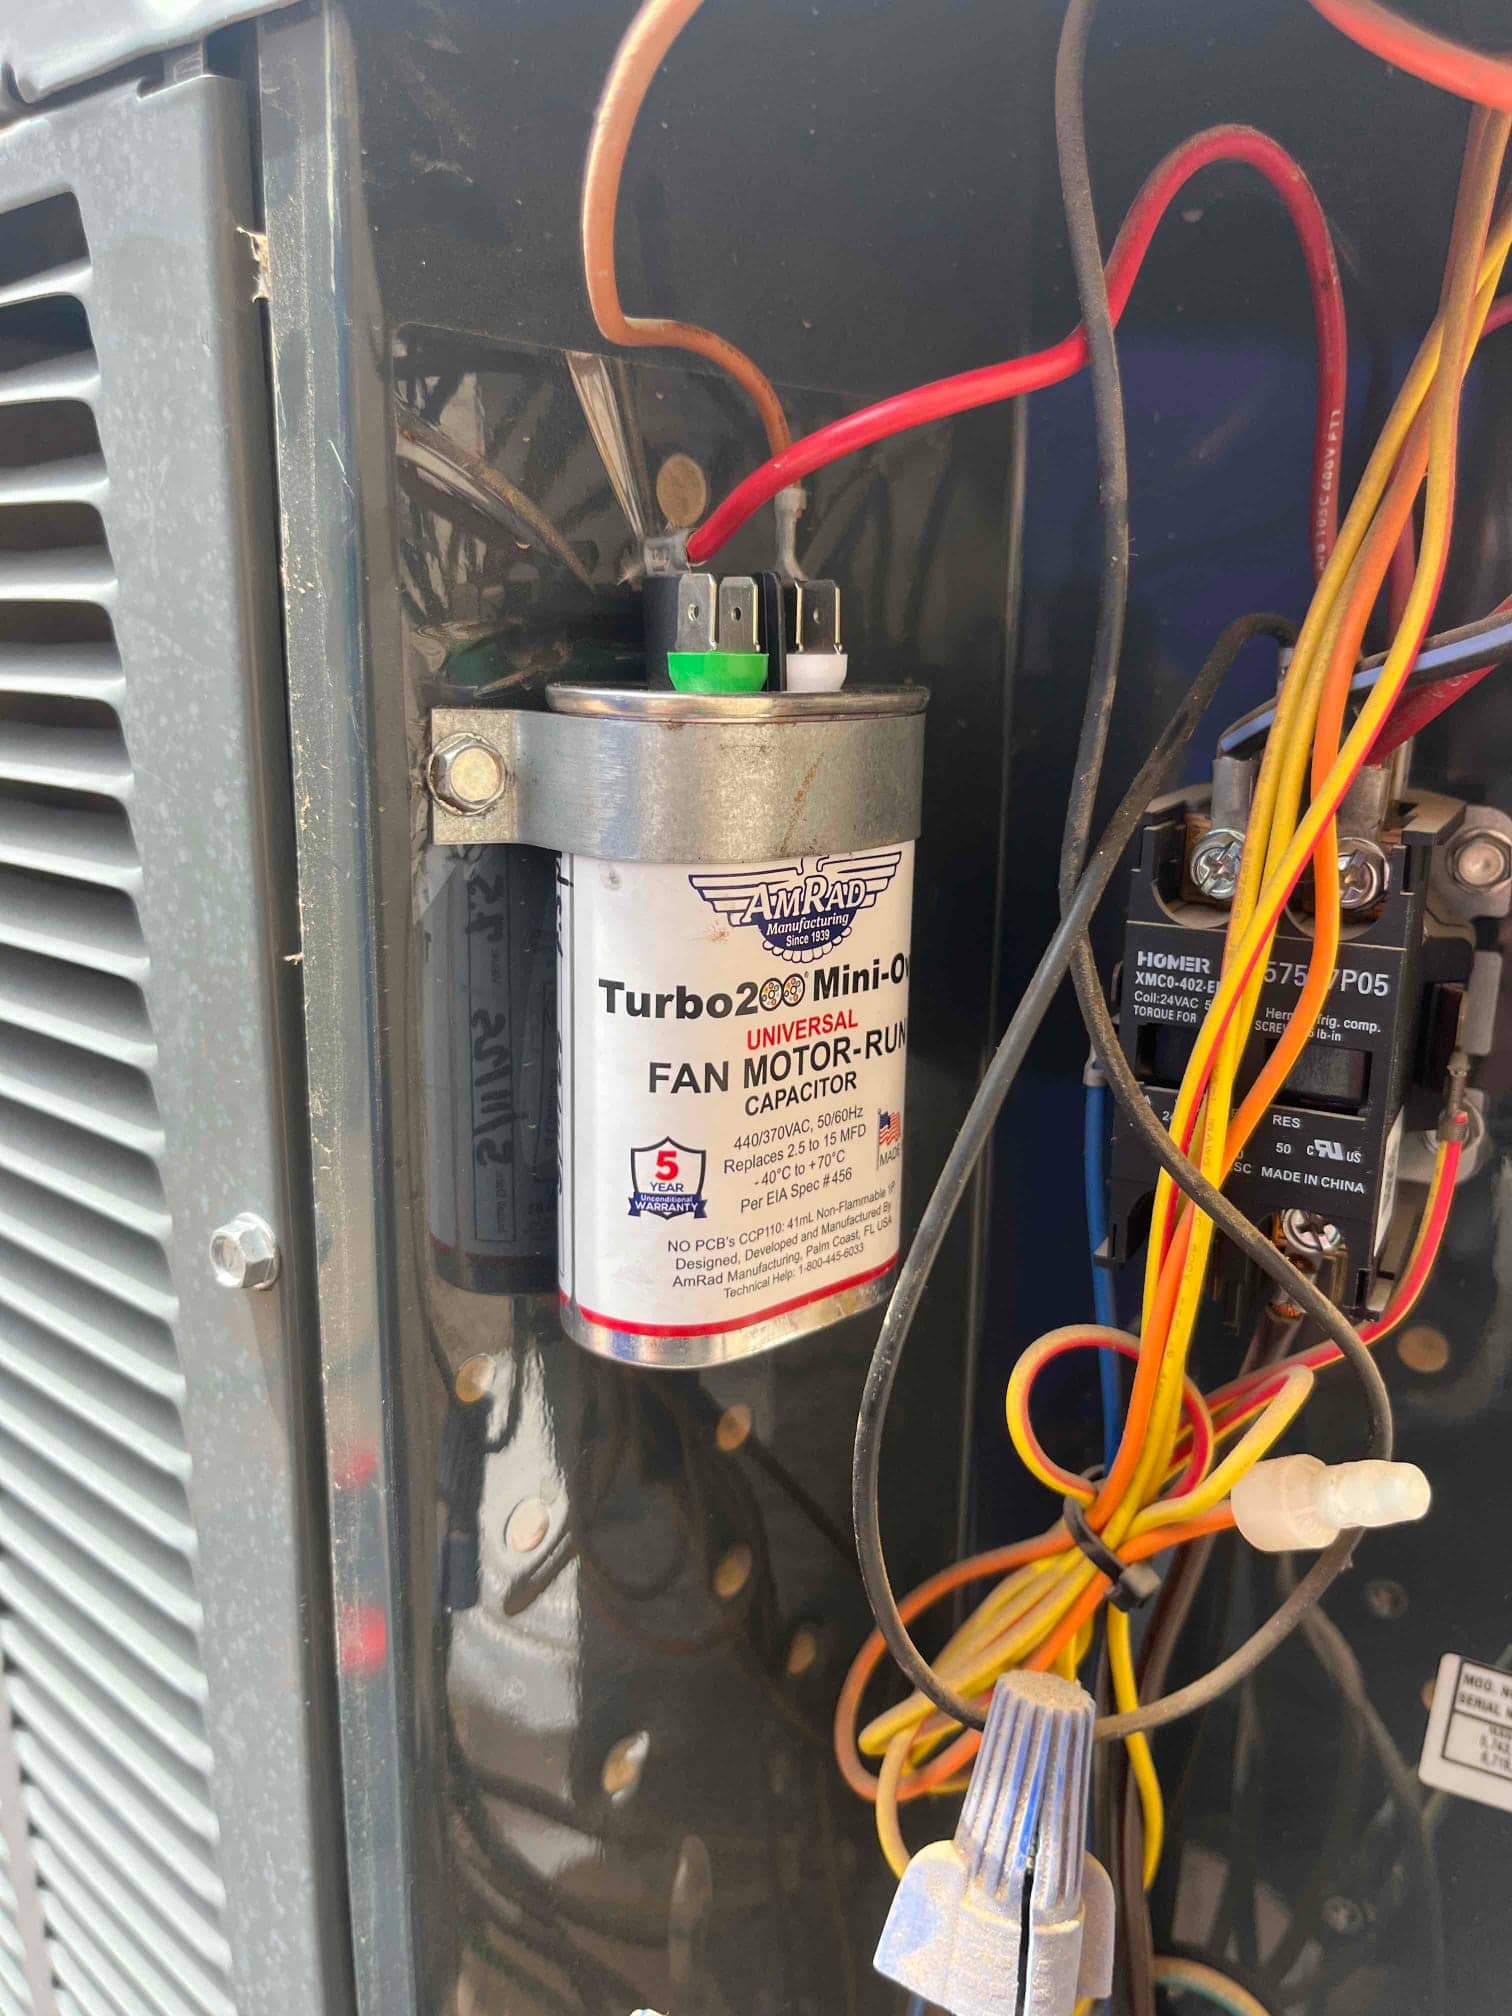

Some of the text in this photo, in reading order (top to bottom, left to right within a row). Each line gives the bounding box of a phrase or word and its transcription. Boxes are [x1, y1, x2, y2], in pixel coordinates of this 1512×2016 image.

[766, 912, 850, 936] Manufacturing
[785, 930, 831, 948] Since 1939
[1136, 950, 1212, 974] HOMER
[1133, 1004, 1198, 1024] TORQUE FOR
[1343, 1018, 1382, 1034] comp.
[746, 1009, 859, 1051] UNIVERSAL
[1316, 1028, 1342, 1042] lb-in
[649, 1020, 906, 1094] FAN MOTOR-RUN
[744, 1071, 858, 1116] CAPACITOR
[733, 1106, 864, 1151] 440/370VAC, 50/60Hz
[1272, 1114, 1302, 1129] RES
[723, 1123, 866, 1175] Replaces 2.5 to 15 MFD
[1275, 1142, 1292, 1155] 50
[655, 1149, 680, 1181] 5
[794, 1161, 806, 1176] to
[649, 1182, 685, 1193] YEAR
[740, 1167, 853, 1214] Per EIA Spec #456
[1261, 1166, 1366, 1194] MADE IN CHINA
[634, 1200, 699, 1213] WARRANTY
[640, 1193, 694, 1203] Unconditional
[667, 1240, 691, 1252] NO
[695, 1236, 736, 1252] PCB's
[787, 1212, 814, 1231] 41mL
[816, 1189, 887, 1220] Non-Flammable
[745, 1234, 799, 1261] Developed
[800, 1226, 819, 1242] and
[821, 1206, 881, 1236] Manufactured
[672, 1272, 724, 1288] AmRad
[805, 1240, 831, 1257] Palm
[832, 1230, 862, 1248] Coast,
[863, 1224, 876, 1238] FL
[877, 1216, 893, 1231] USA
[723, 1242, 865, 1299] Technical Help: 1-800-445-6033
